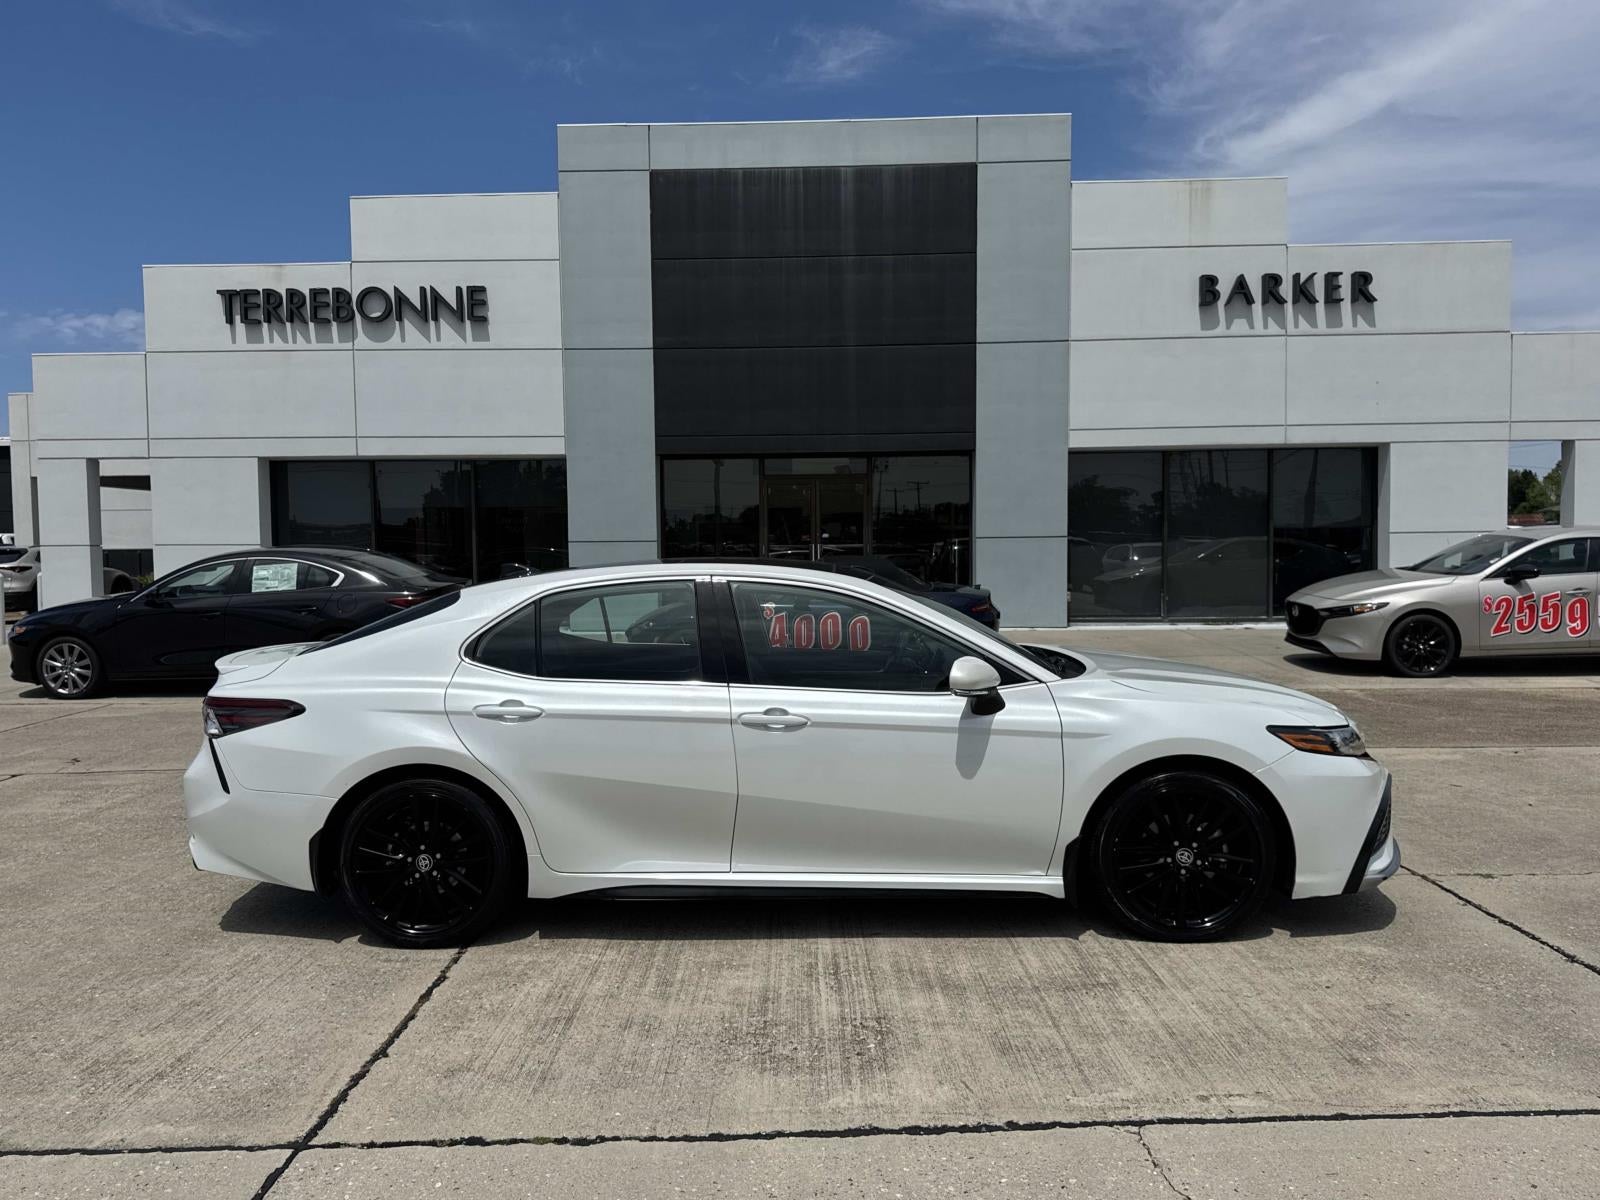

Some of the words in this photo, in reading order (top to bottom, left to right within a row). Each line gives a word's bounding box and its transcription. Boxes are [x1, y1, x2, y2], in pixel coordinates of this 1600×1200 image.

[216, 285, 488, 324] TERREBONNE
[1198, 271, 1378, 306] BARKER
[1482, 591, 1590, 637] $2559
